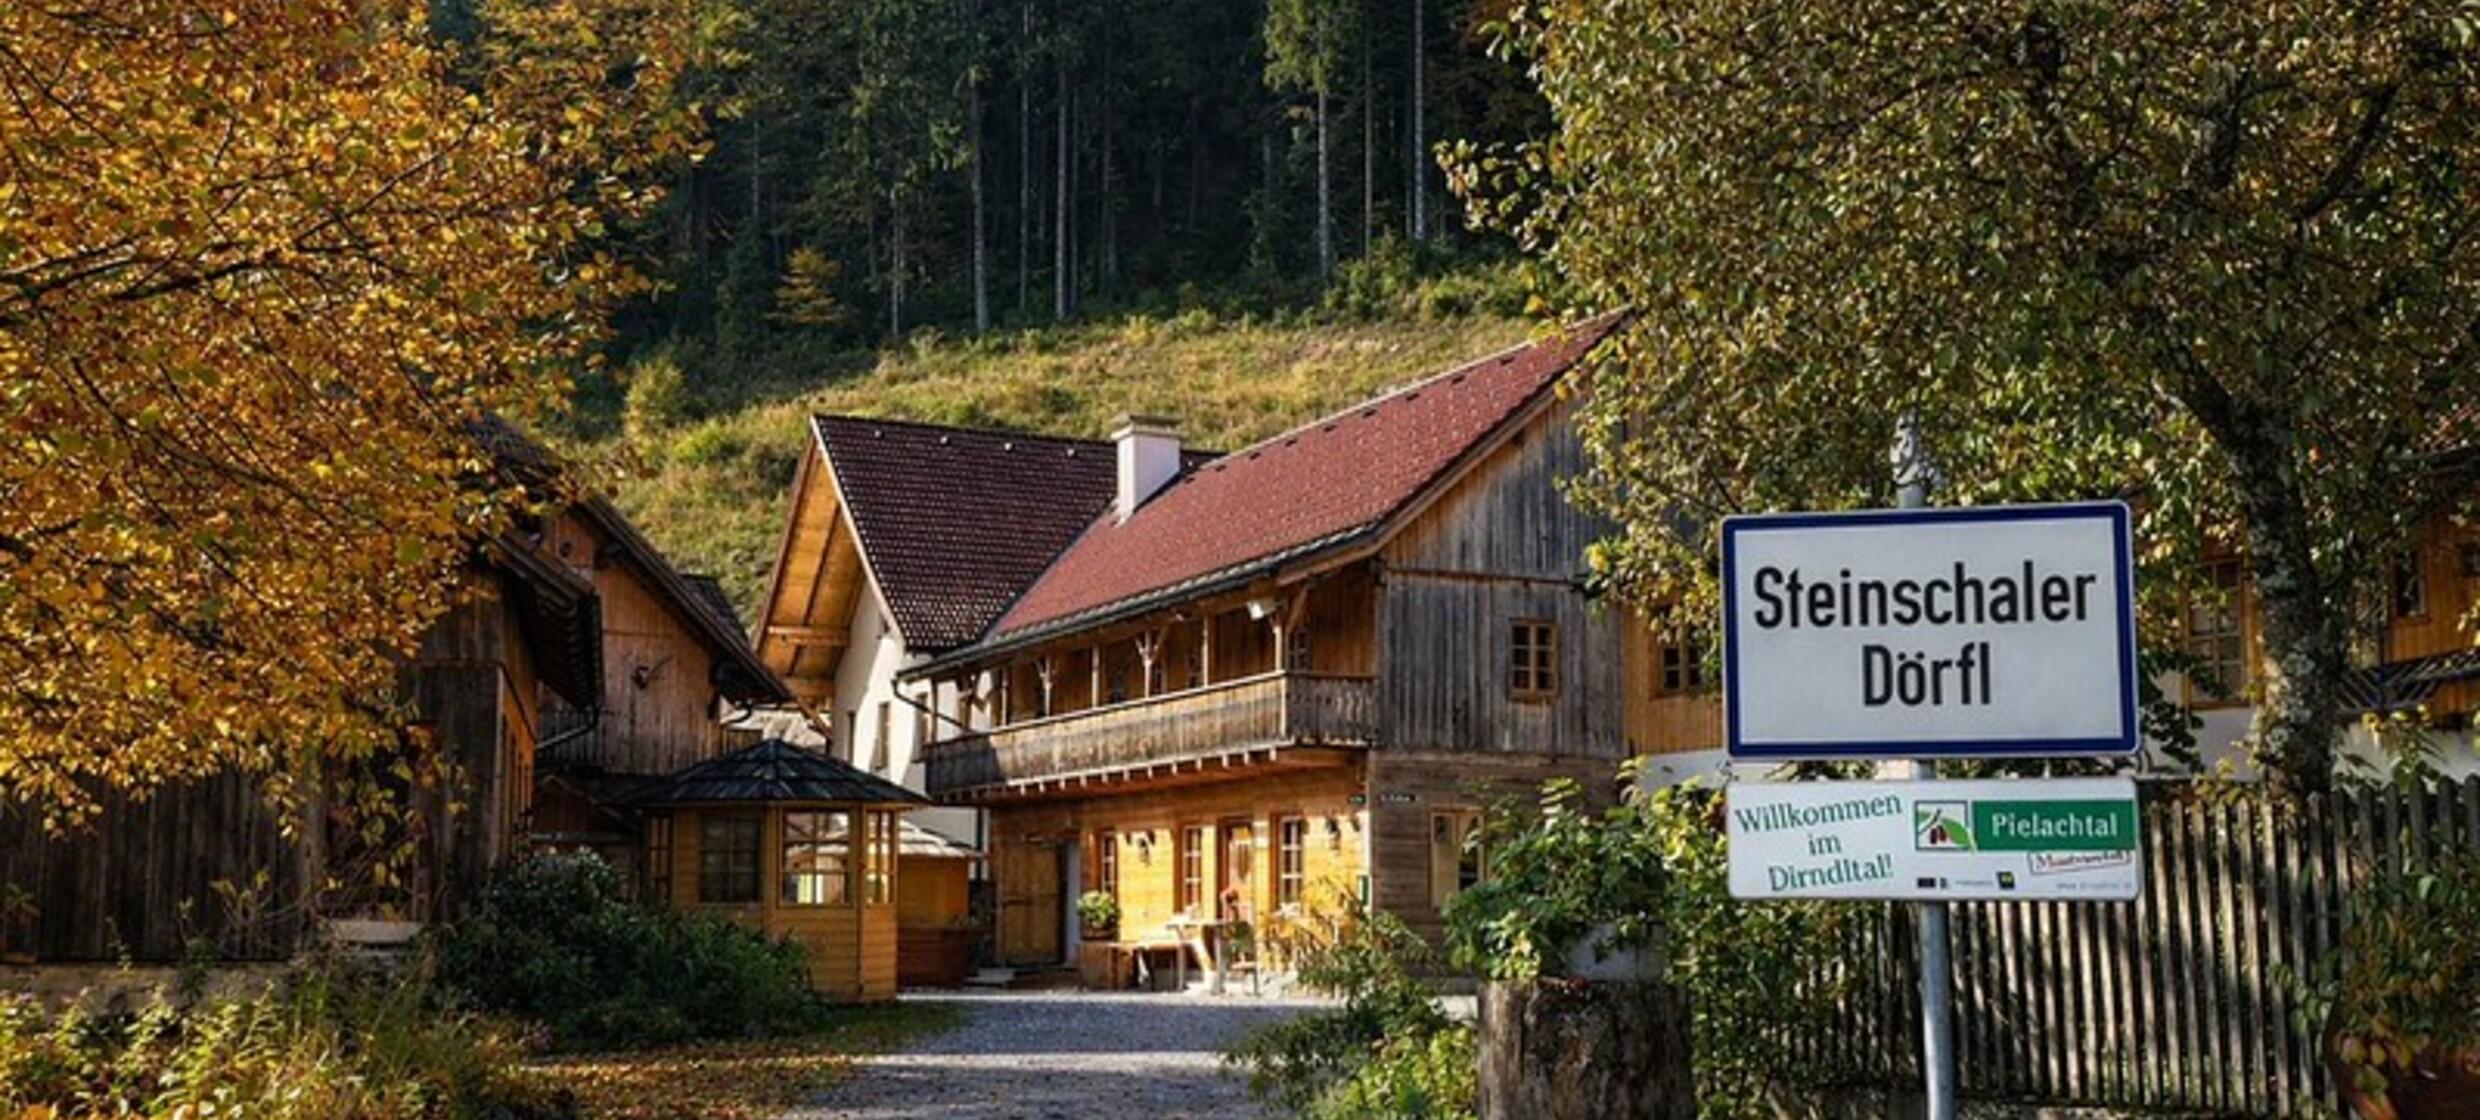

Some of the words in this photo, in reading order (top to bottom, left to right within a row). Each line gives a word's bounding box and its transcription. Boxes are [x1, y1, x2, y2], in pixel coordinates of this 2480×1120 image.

[1753, 560, 2096, 629] Steinschaler
[1862, 642, 1991, 707] Dörfl
[1735, 793, 1903, 833] Willkommen
[1991, 812, 2118, 838] Pielachtal
[1808, 833, 1842, 855] im
[1768, 852, 1894, 892] Dirndltal!
